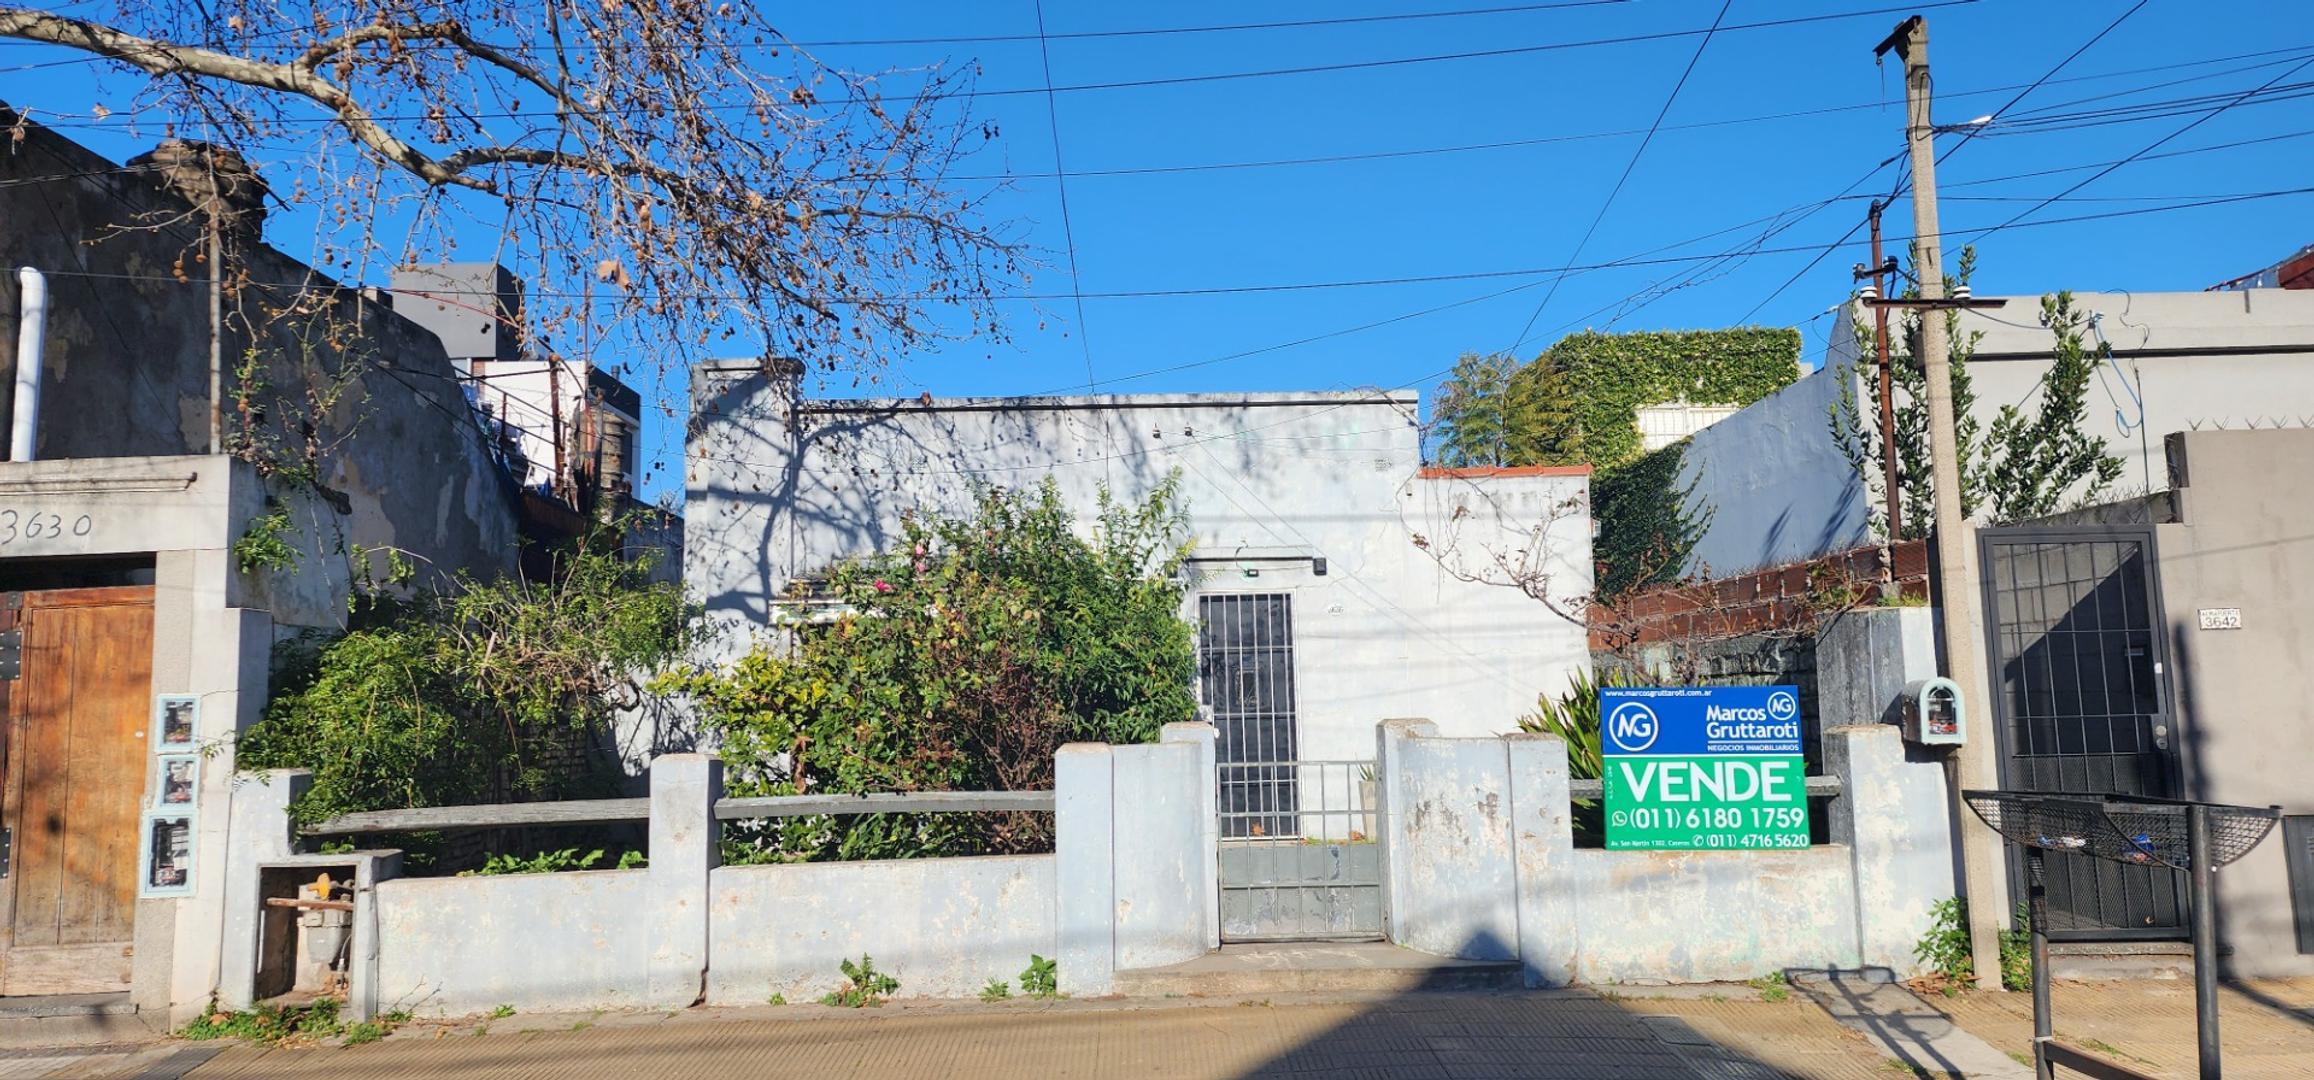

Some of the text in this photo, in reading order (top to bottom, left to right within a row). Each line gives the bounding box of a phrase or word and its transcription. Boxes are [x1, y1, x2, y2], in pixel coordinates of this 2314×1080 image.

[1, 509, 92, 545] 3630
[2205, 616, 2237, 627] 3642
[1604, 689, 1713, 698] www.marcosgruttaroti.com.ar
[1706, 704, 1767, 721] Marcos
[1617, 713, 1651, 738] NG
[1706, 721, 1799, 739] Gruttaroti
[1707, 743, 1800, 752] NEGOCIOS INMOBILIARIOS
[1619, 761, 1792, 802] VENDE
[1630, 807, 1805, 829] (011) 6180 1759
[1706, 834, 1809, 848] (011) 4716 5620
